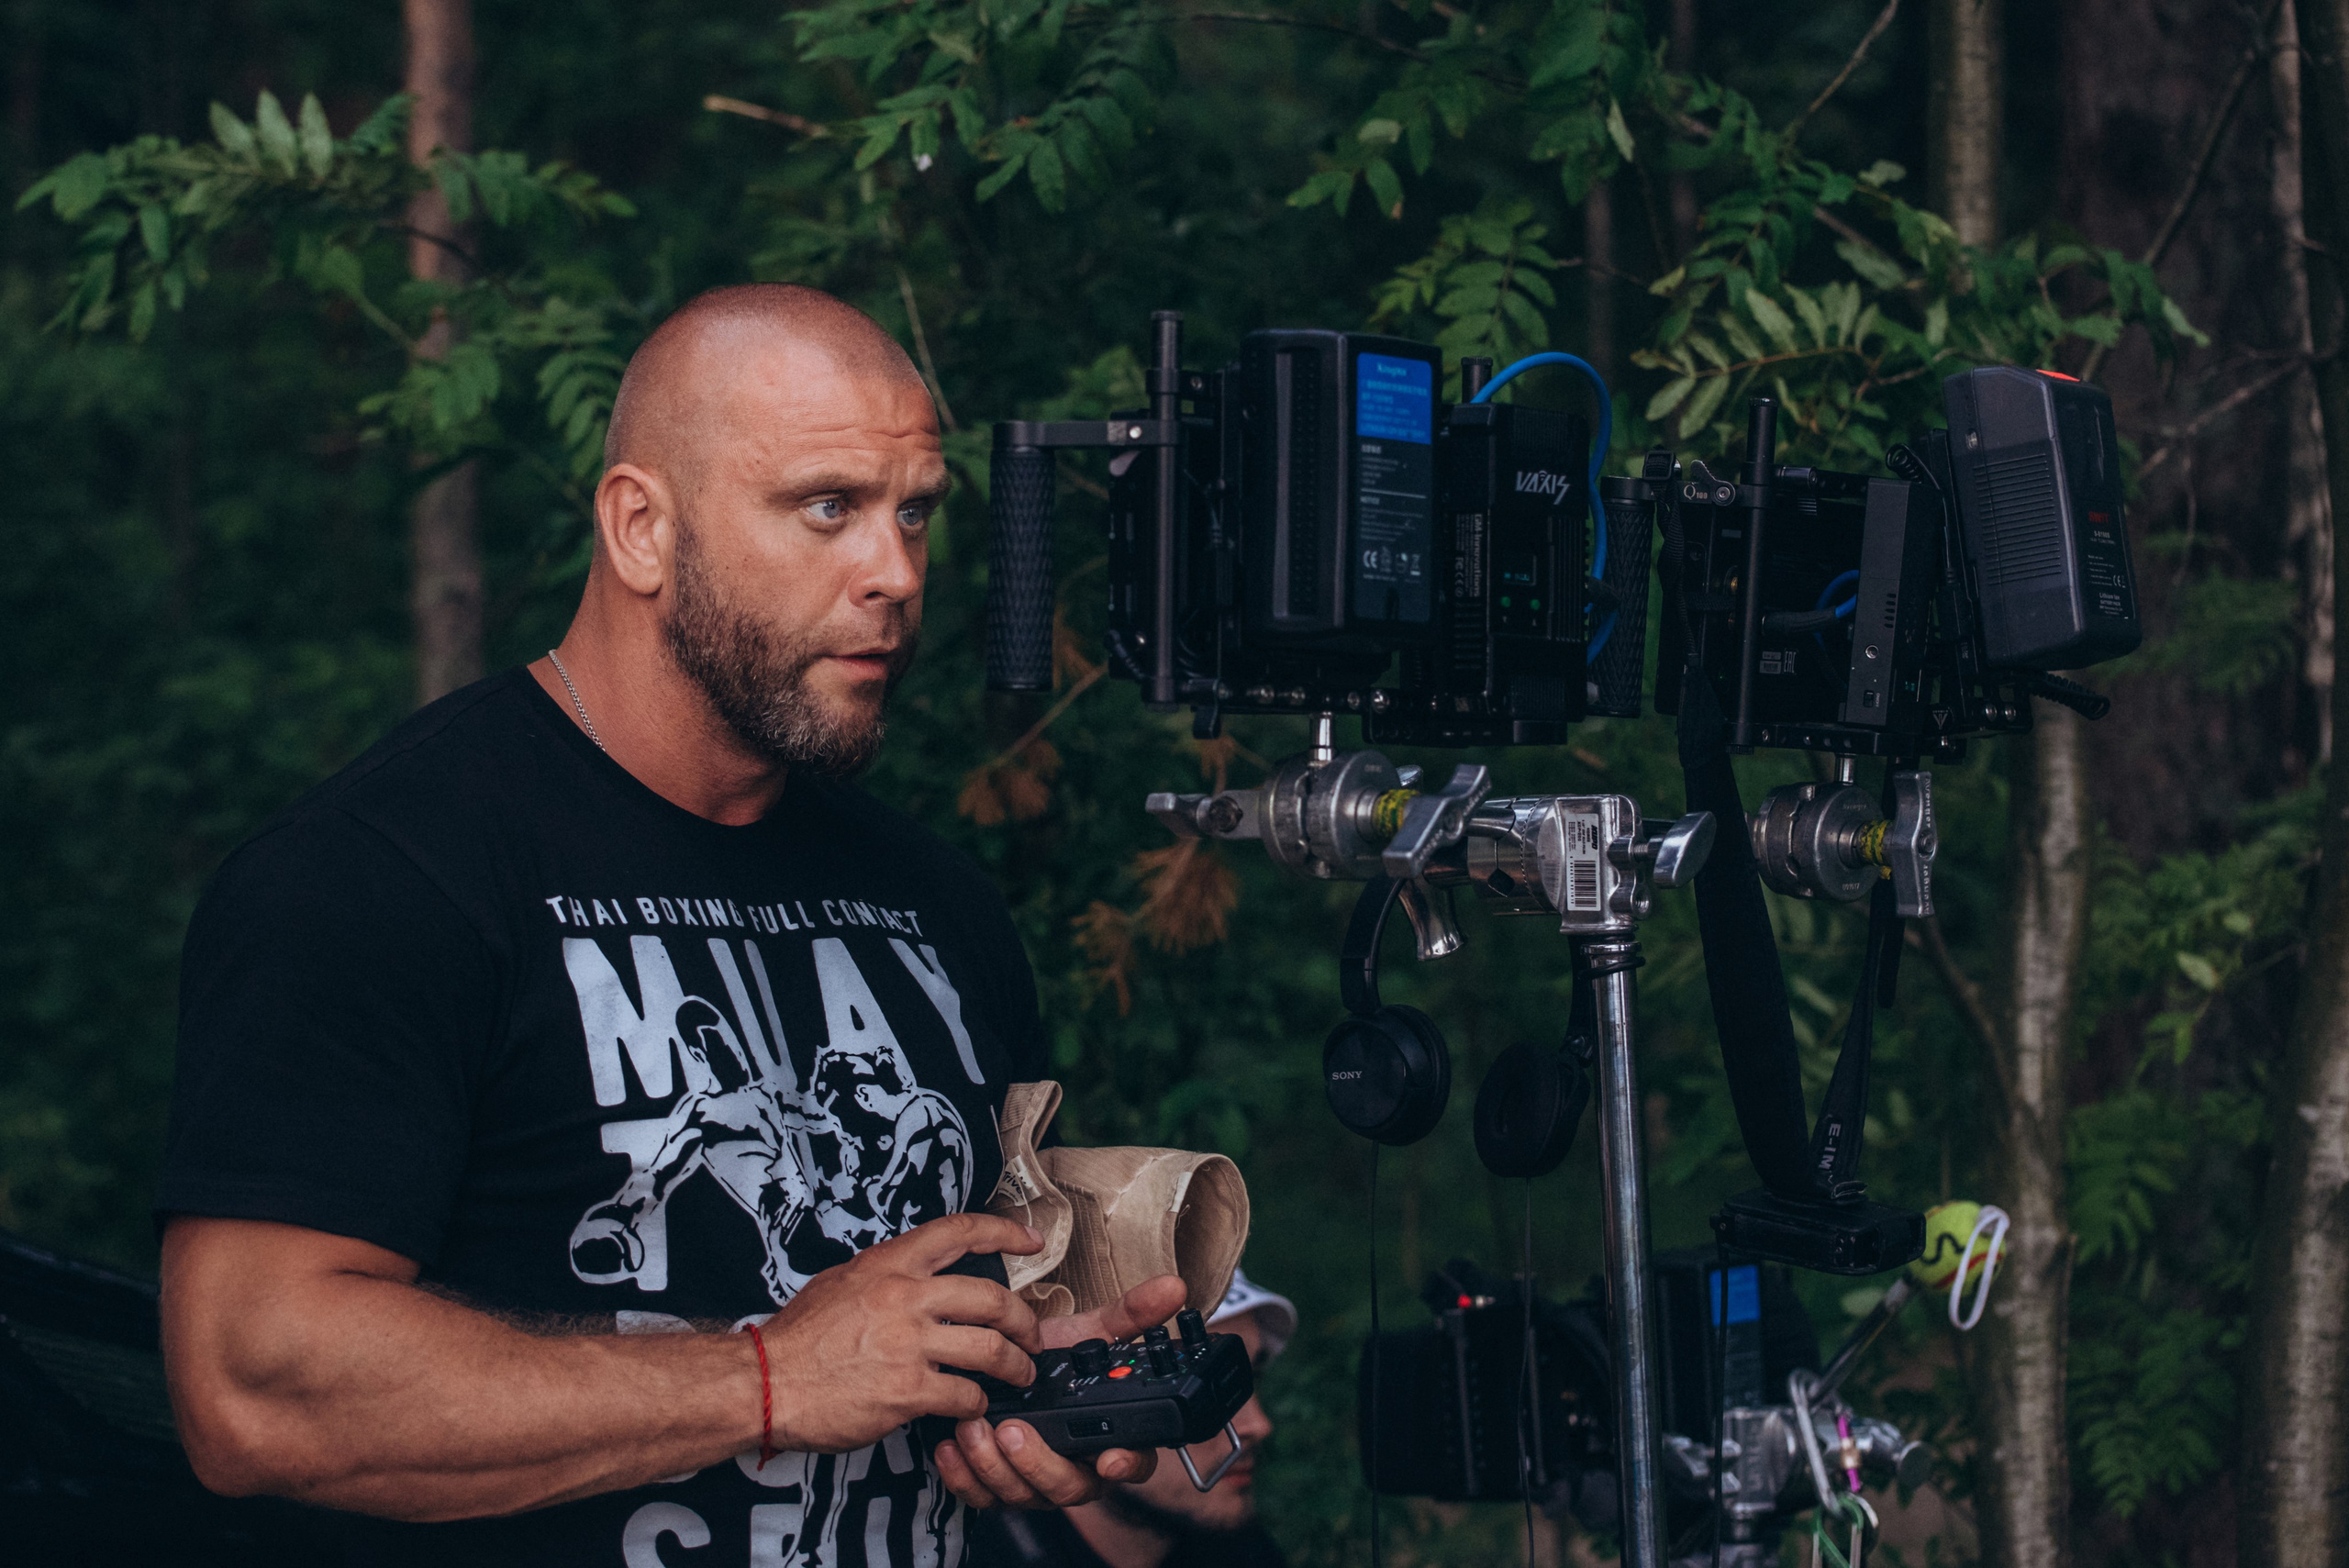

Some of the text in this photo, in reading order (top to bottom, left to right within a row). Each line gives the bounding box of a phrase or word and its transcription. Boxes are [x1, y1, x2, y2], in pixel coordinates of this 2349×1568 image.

[545, 895, 629, 927] THAI
[636, 896, 745, 928] BOXING
[747, 901, 816, 934] FULL
[562, 934, 985, 1106] MUAY
[1331, 1070, 1364, 1081] SONY
[1818, 1124, 1842, 1172] E-IM
